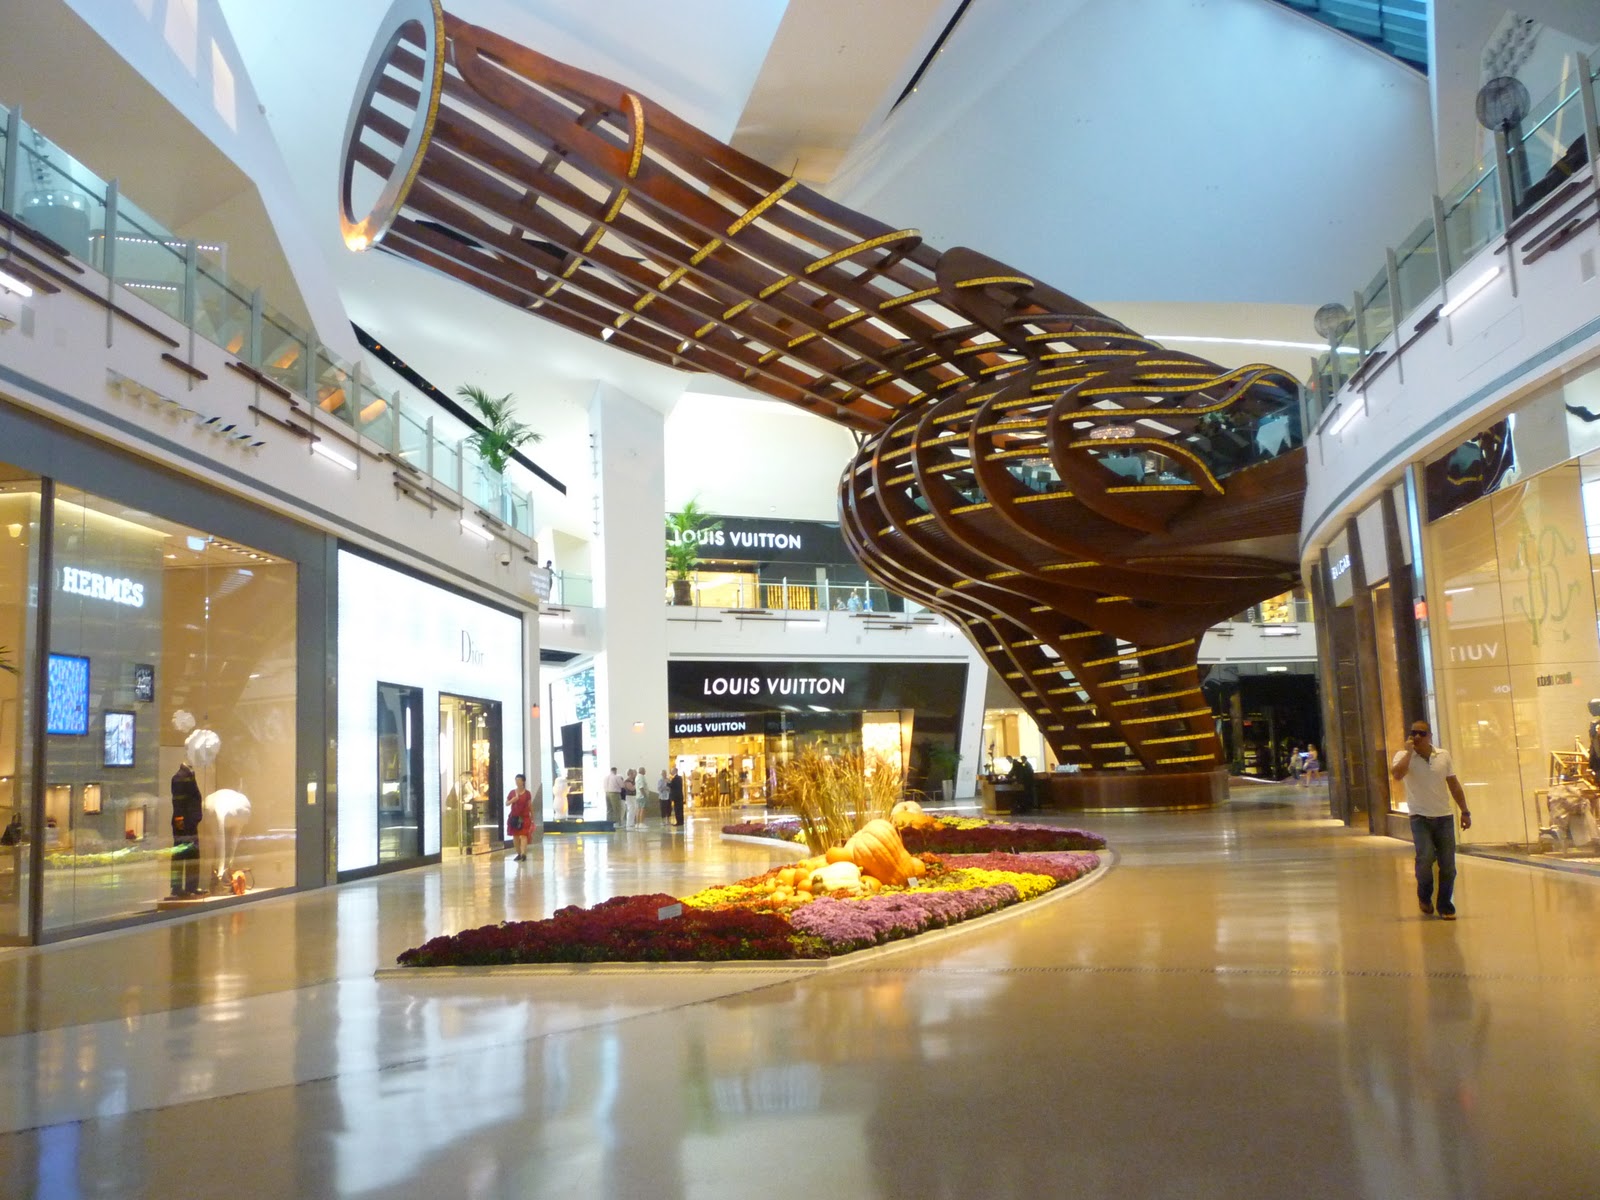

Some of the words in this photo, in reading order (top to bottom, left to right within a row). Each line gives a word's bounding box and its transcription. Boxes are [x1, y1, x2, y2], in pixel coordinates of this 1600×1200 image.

[674, 529, 725, 546] LOUIS
[729, 531, 802, 549] VUITTON
[461, 629, 484, 668] Dior
[703, 677, 760, 695] LOUIS
[766, 677, 846, 695] VUITTON
[674, 723, 703, 734] LOUIS
[705, 721, 747, 733] VUITTON
